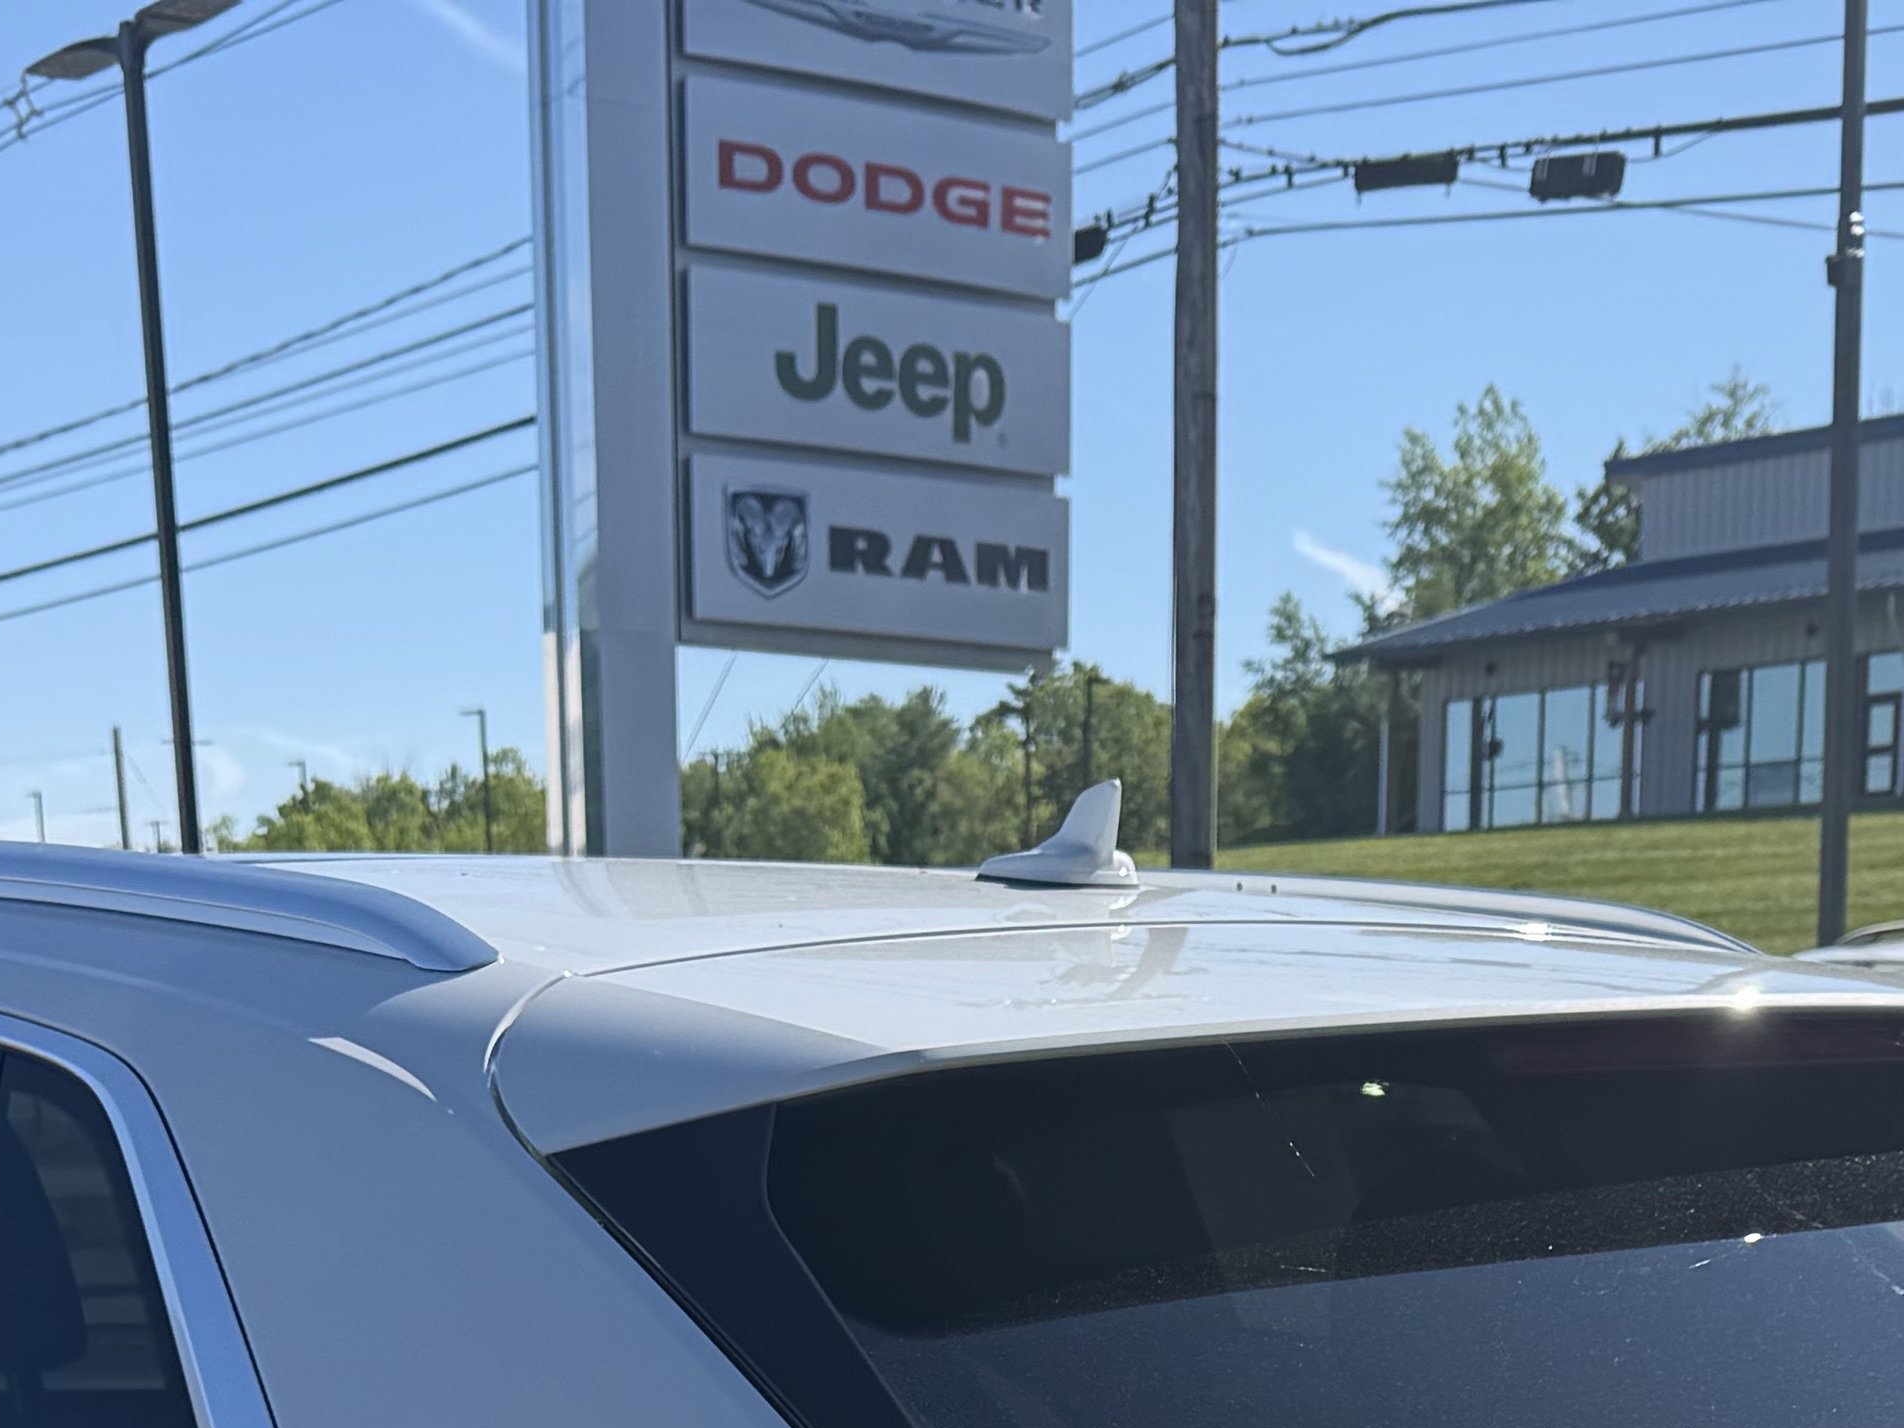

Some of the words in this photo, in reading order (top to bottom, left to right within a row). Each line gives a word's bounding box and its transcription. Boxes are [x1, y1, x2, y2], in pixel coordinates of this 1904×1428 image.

[718, 138, 1052, 240] DODGE
[775, 302, 1006, 444] Jeep
[829, 525, 1050, 592] RAM
